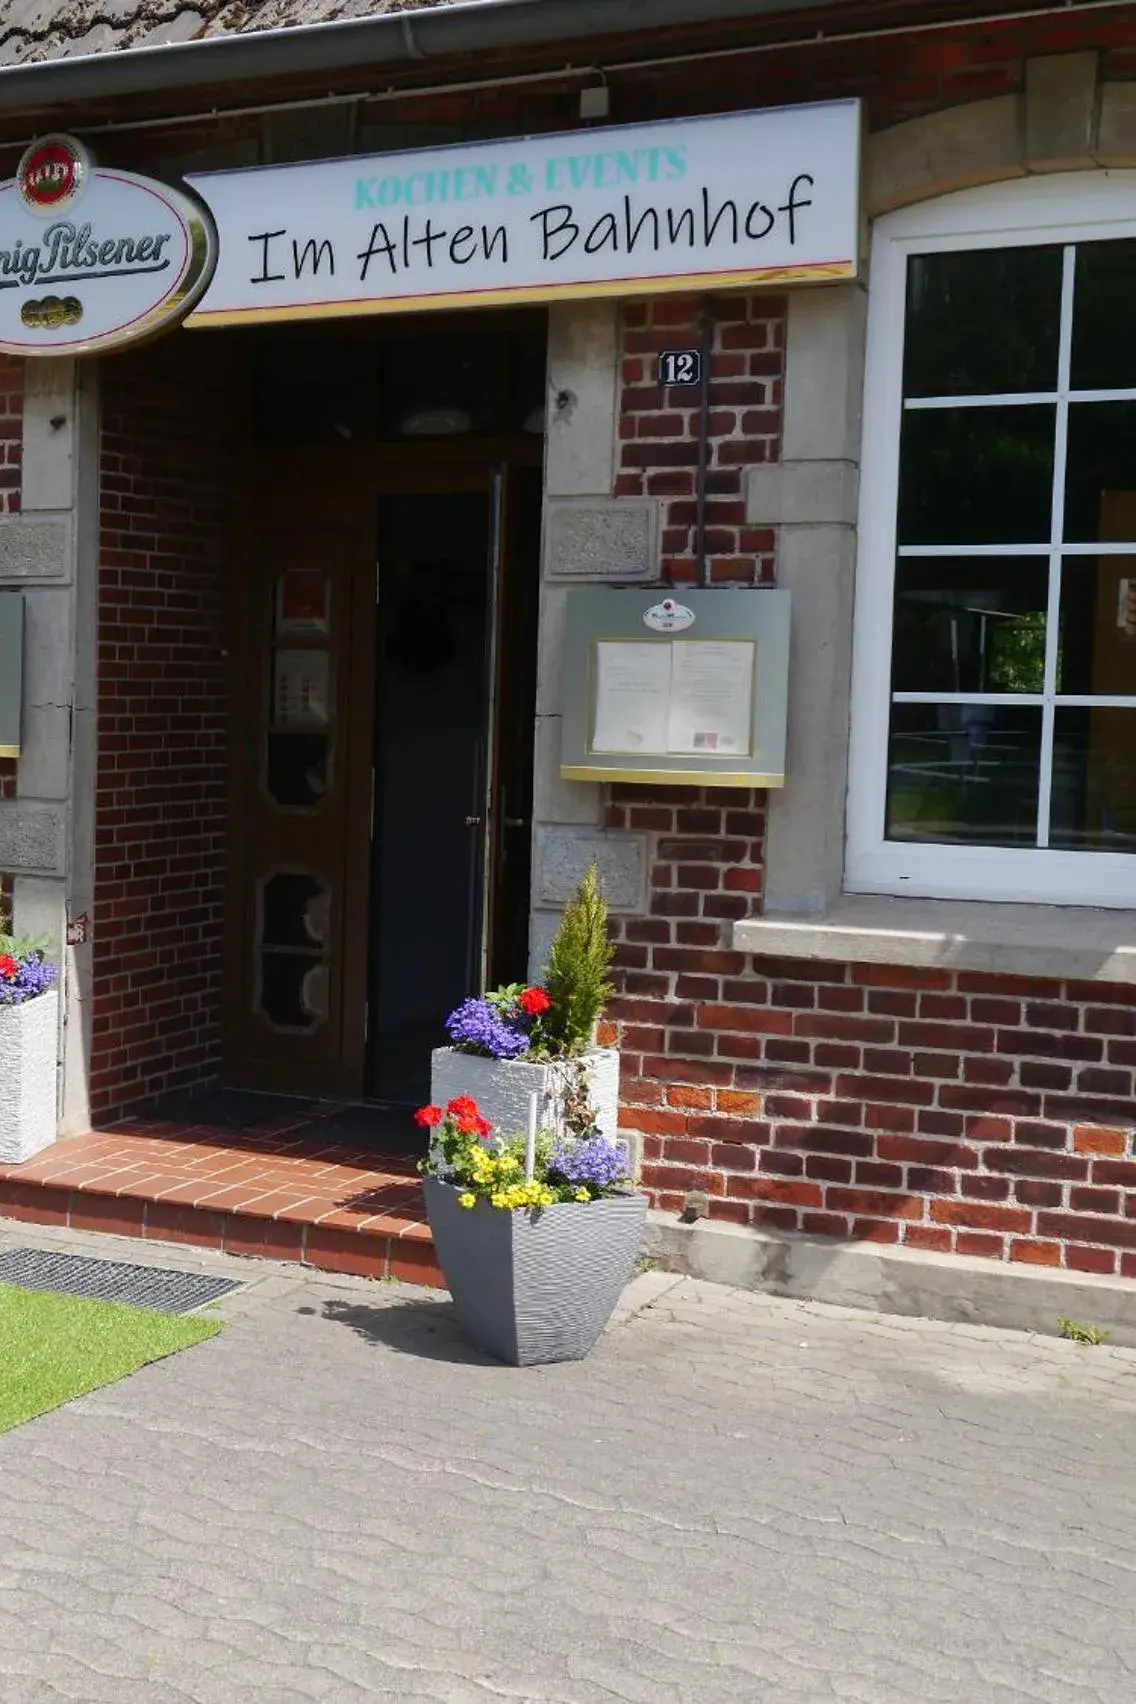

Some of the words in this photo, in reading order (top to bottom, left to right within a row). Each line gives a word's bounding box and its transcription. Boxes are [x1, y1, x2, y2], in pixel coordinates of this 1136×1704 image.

[352, 164, 498, 211] KOCHEN
[505, 162, 535, 195] &
[544, 145, 690, 192] EVENTS
[38, 221, 172, 273] Pilsener
[248, 229, 336, 285] Im
[356, 214, 510, 282] Alten
[530, 173, 815, 261] Bahnhof
[666, 354, 693, 382] 12
